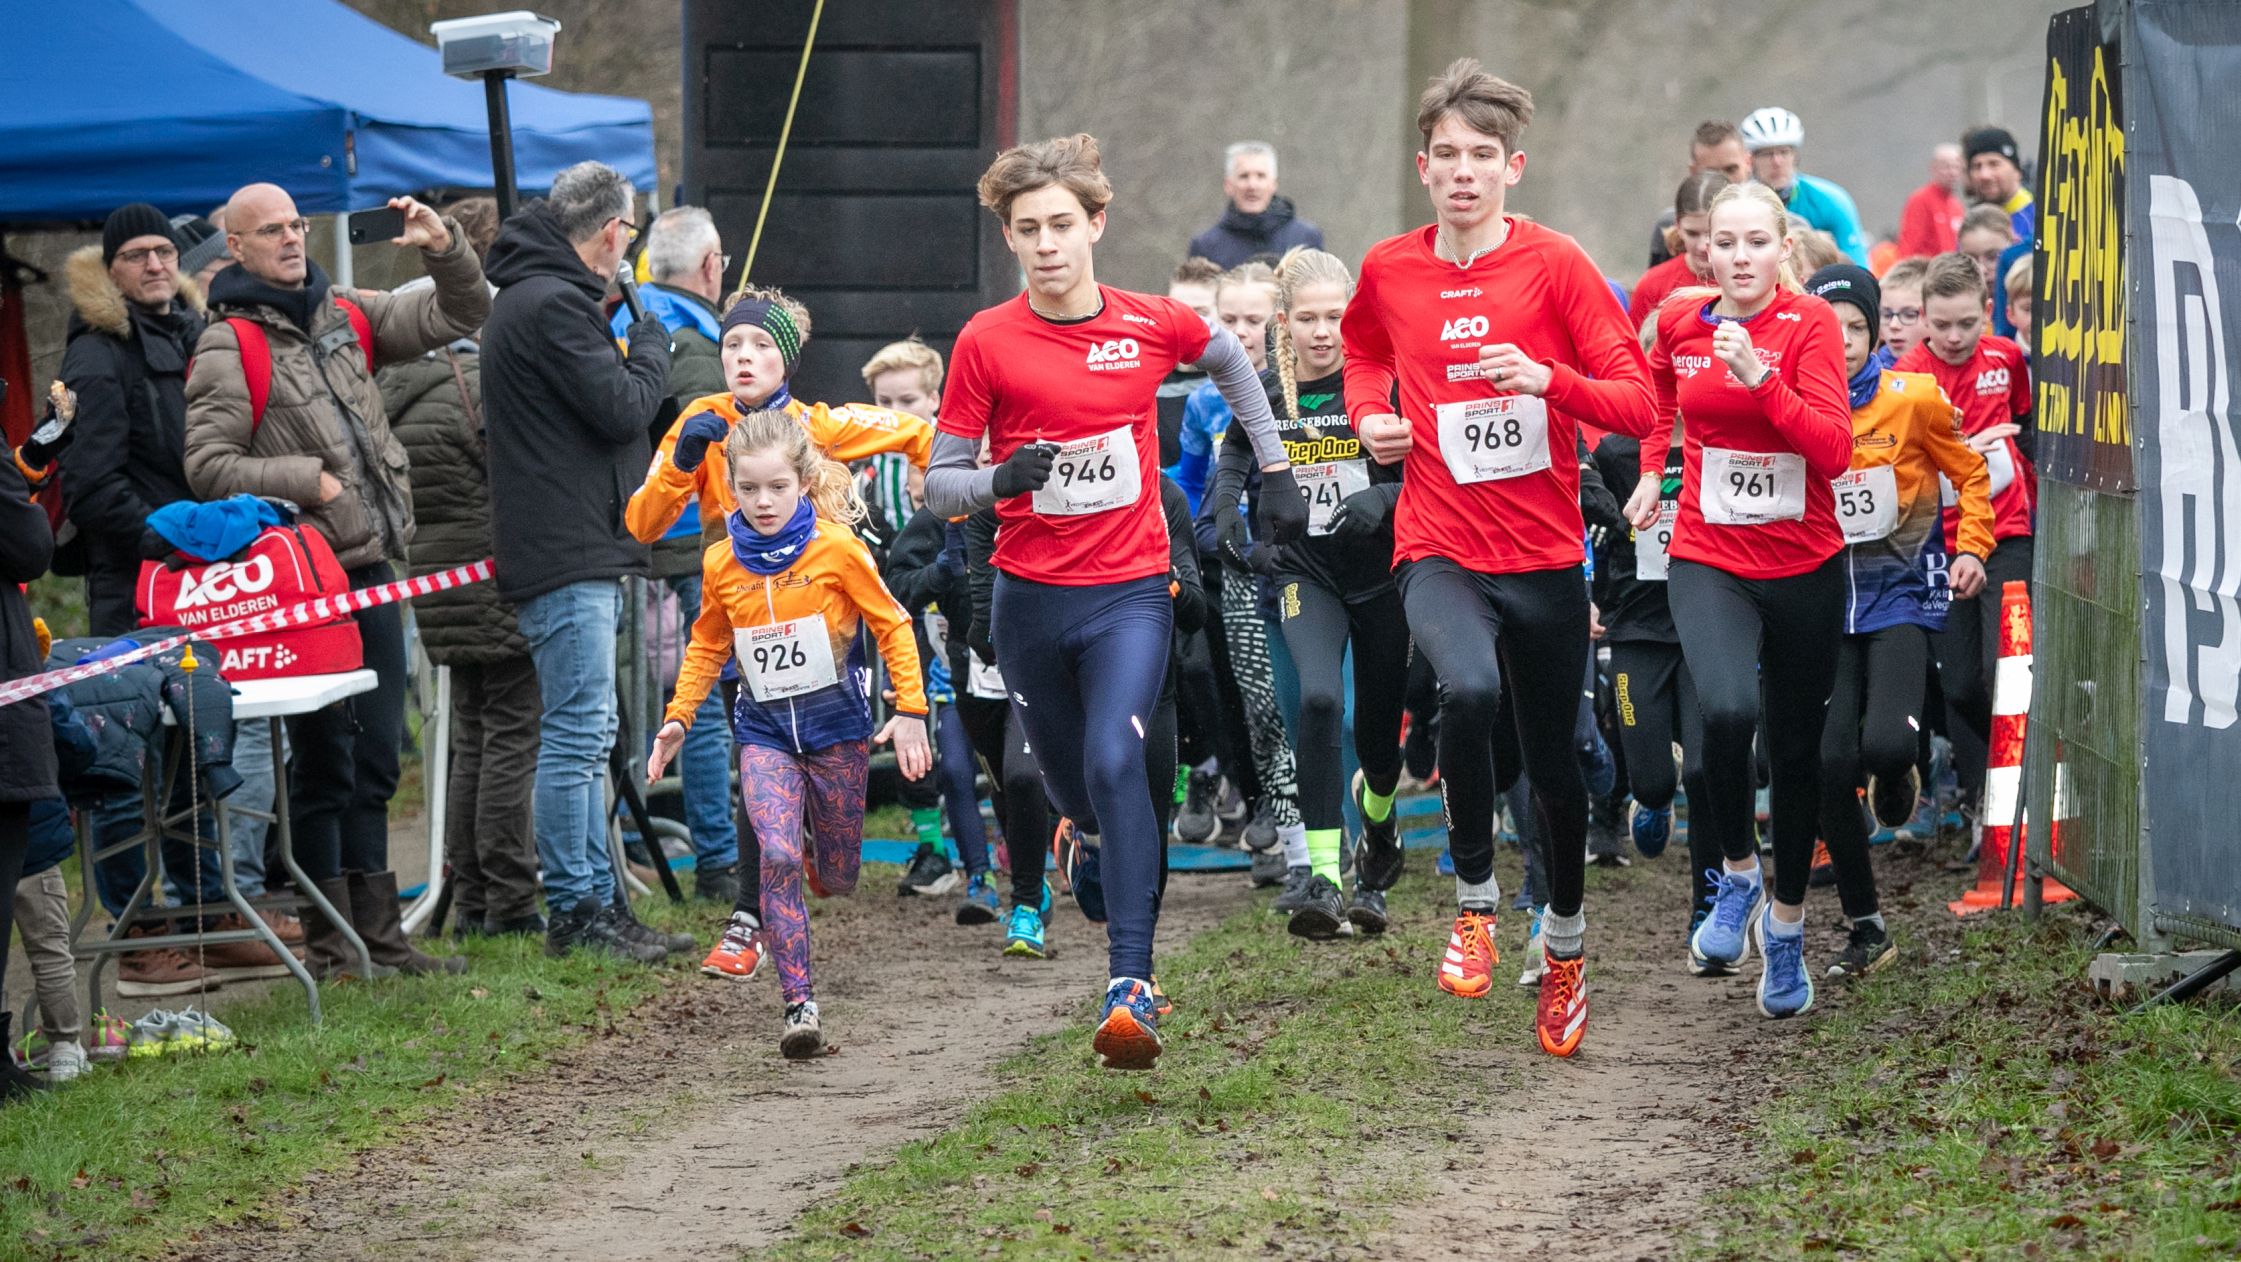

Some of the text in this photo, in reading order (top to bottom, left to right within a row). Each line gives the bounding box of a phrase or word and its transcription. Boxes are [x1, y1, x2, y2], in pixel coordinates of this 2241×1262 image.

[1440, 288, 1473, 299] CRAFT
[1440, 315, 1489, 341] ACO
[1086, 338, 1139, 363] ACO
[1088, 360, 1140, 372] VAN ELDEREN
[1464, 408, 1500, 418] SPORT
[1465, 400, 1501, 411] PRINS
[1275, 414, 1351, 432] REGEBORG
[1464, 418, 1523, 453] 968
[1060, 446, 1097, 457] SPORT
[1061, 439, 1097, 451] PRINS
[1282, 441, 1321, 465] tep
[1730, 453, 1763, 462] PRINS
[1728, 458, 1762, 467] SPORT
[1058, 454, 1116, 488] 946
[1295, 471, 1325, 480] SPORT
[1729, 471, 1774, 498] 961
[1299, 481, 1342, 507] 941
[174, 553, 275, 610] ACO
[178, 594, 278, 627] VAN ELDEREN
[752, 625, 784, 636] PRINS
[752, 631, 783, 642] SPORT
[753, 640, 807, 674] 926
